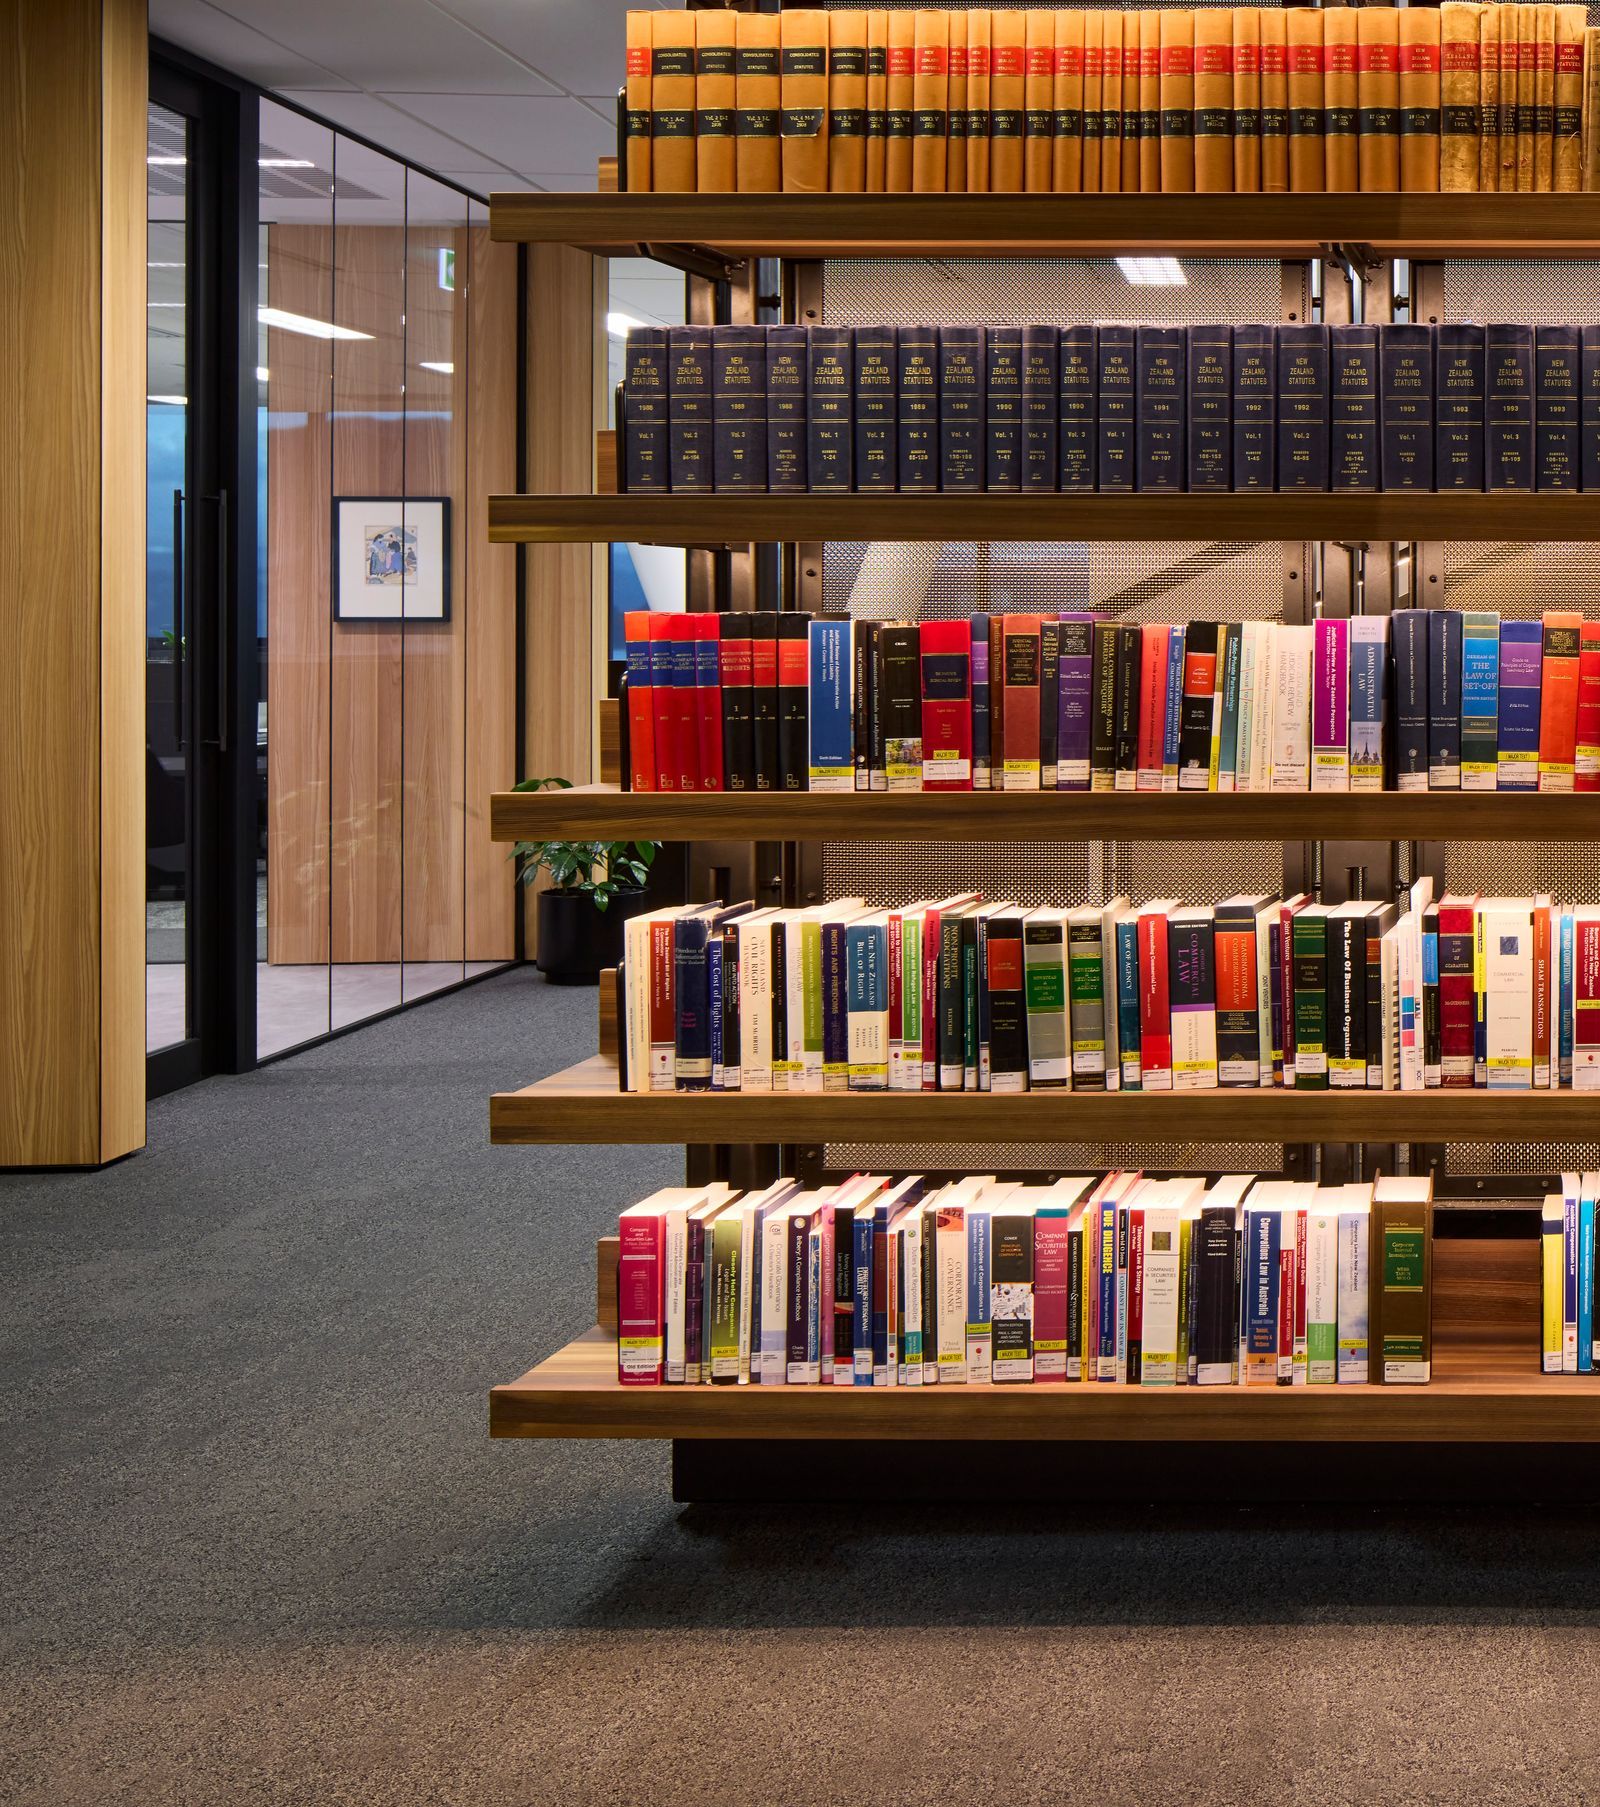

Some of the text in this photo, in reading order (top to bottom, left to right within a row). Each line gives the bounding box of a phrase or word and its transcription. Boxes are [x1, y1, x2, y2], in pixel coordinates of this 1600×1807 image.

[814, 376, 844, 384] STATUTES
[1102, 666, 1108, 676] OF
[1367, 646, 1375, 719] ADMINISTRATIVE
[1125, 950, 1131, 960] OF
[1191, 933, 1199, 996] COMMERCIAL
[1178, 949, 1190, 983] LAW
[1345, 961, 1351, 971] Of
[712, 948, 722, 1028] The Cost of Rights
[1034, 1241, 1067, 1250] SECURITIES
[1035, 1231, 1066, 1240] COMPANY
[1103, 1210, 1113, 1274] DUE DILIGENCE
[1259, 1218, 1271, 1260] Corporations
[1260, 1262, 1269, 1276] Law
[1259, 1286, 1269, 1315] Australia
